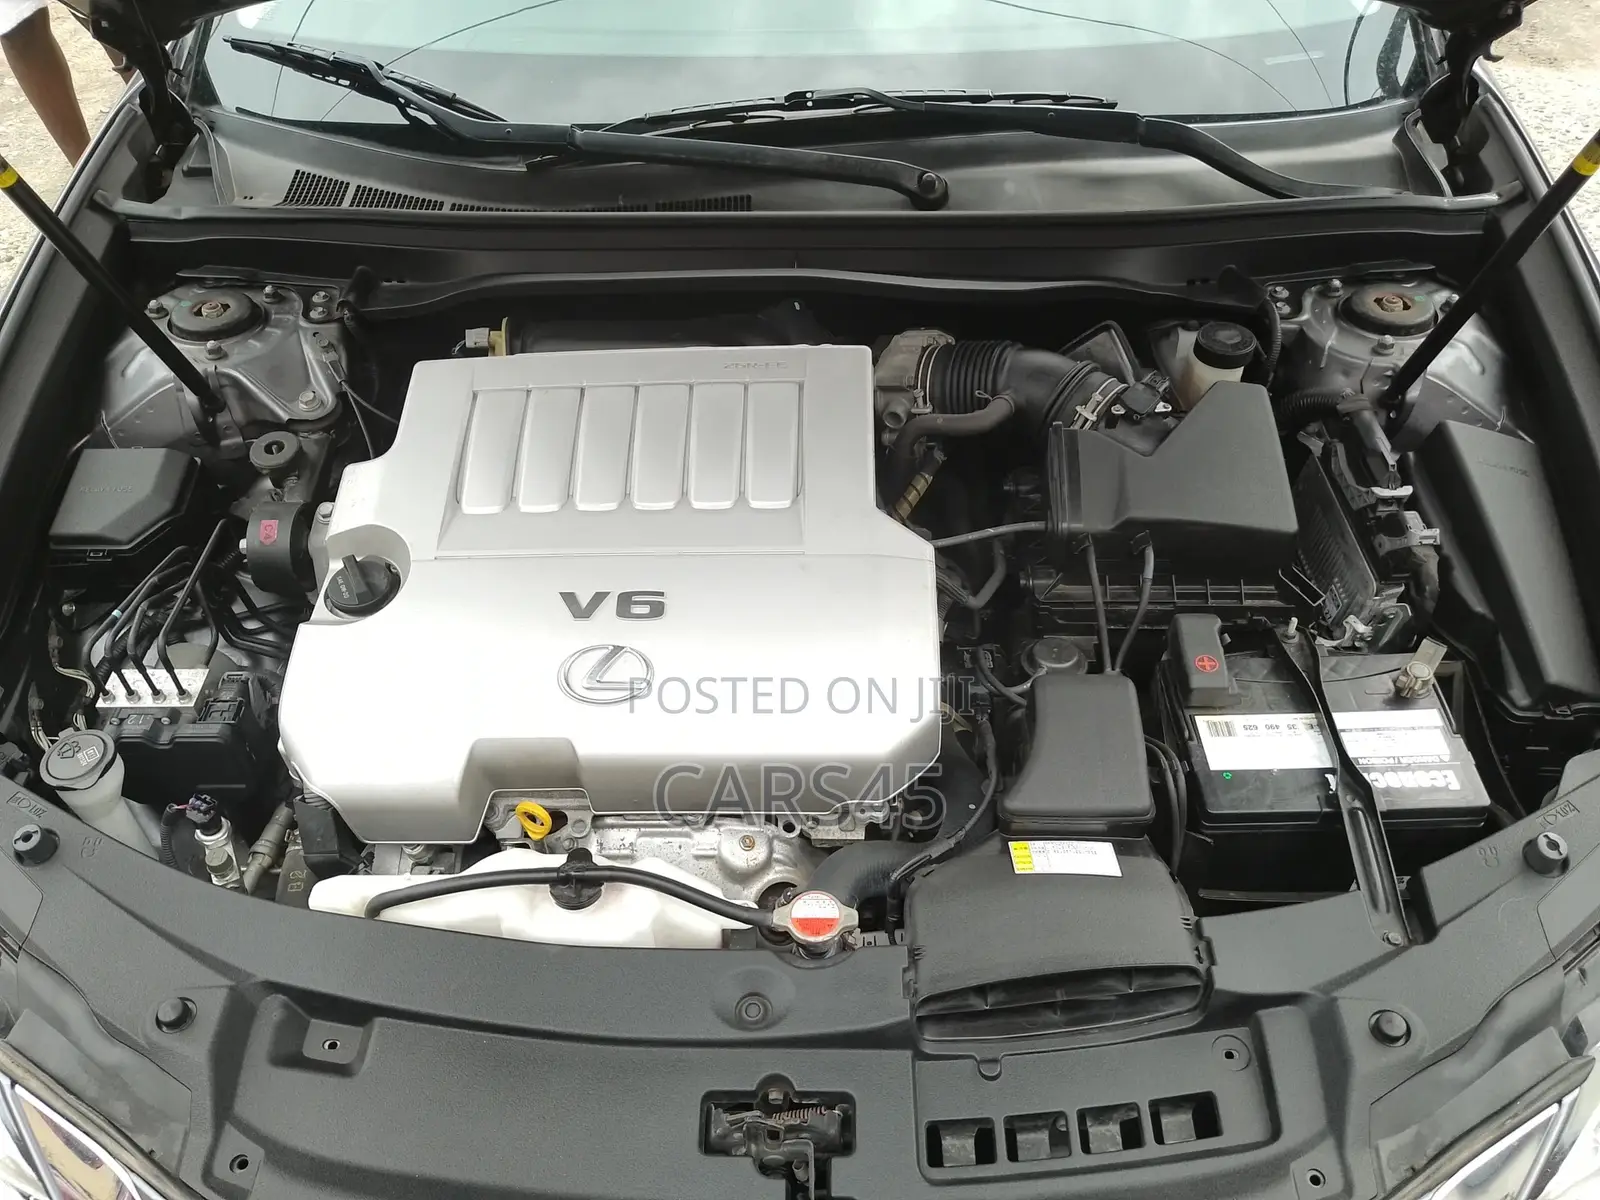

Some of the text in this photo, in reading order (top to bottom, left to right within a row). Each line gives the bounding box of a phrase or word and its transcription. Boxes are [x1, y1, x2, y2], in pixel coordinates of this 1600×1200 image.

[558, 590, 666, 621] V6
[1242, 723, 1259, 731] 625
[1264, 723, 1280, 731] 490
